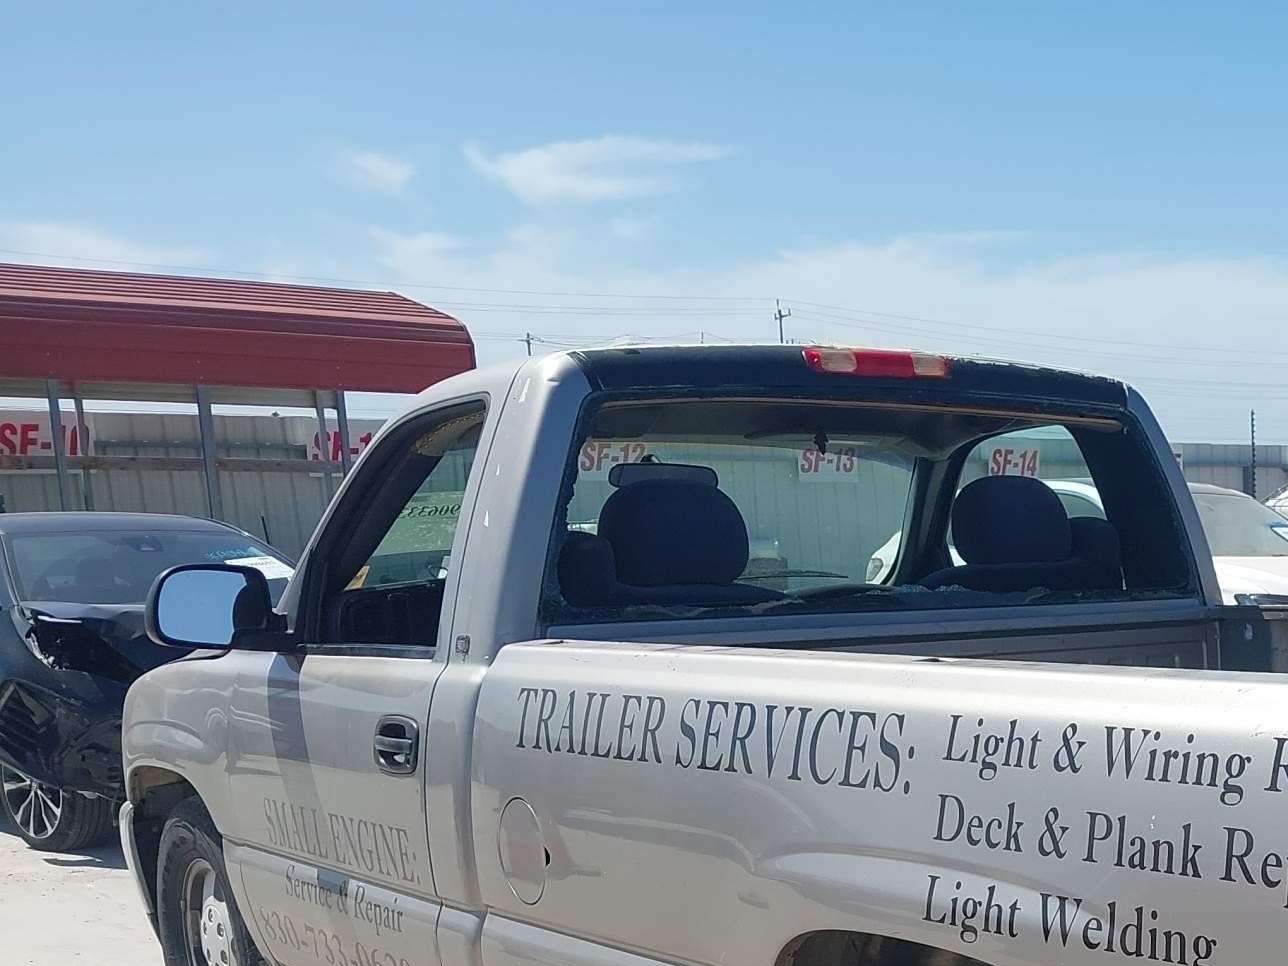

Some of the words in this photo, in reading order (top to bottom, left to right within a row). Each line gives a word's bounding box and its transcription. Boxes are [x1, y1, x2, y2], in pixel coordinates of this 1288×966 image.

[581, 441, 646, 471] SF-12
[801, 447, 856, 473] SF-13
[991, 449, 1038, 476] SF-14
[516, 687, 666, 765] TRAILER
[675, 698, 916, 795] SERVICES:
[941, 714, 1042, 781] Light
[1053, 722, 1086, 775] &
[1104, 725, 1252, 806] Wiring
[263, 797, 328, 860] SMALL
[328, 812, 421, 885] ENGINE:
[933, 794, 1024, 853] Deck
[1036, 806, 1070, 860] &
[1081, 811, 1202, 878] Plank
[286, 864, 333, 910] Service
[337, 880, 349, 915] &
[354, 884, 403, 936] Repair
[921, 874, 1022, 944] Light
